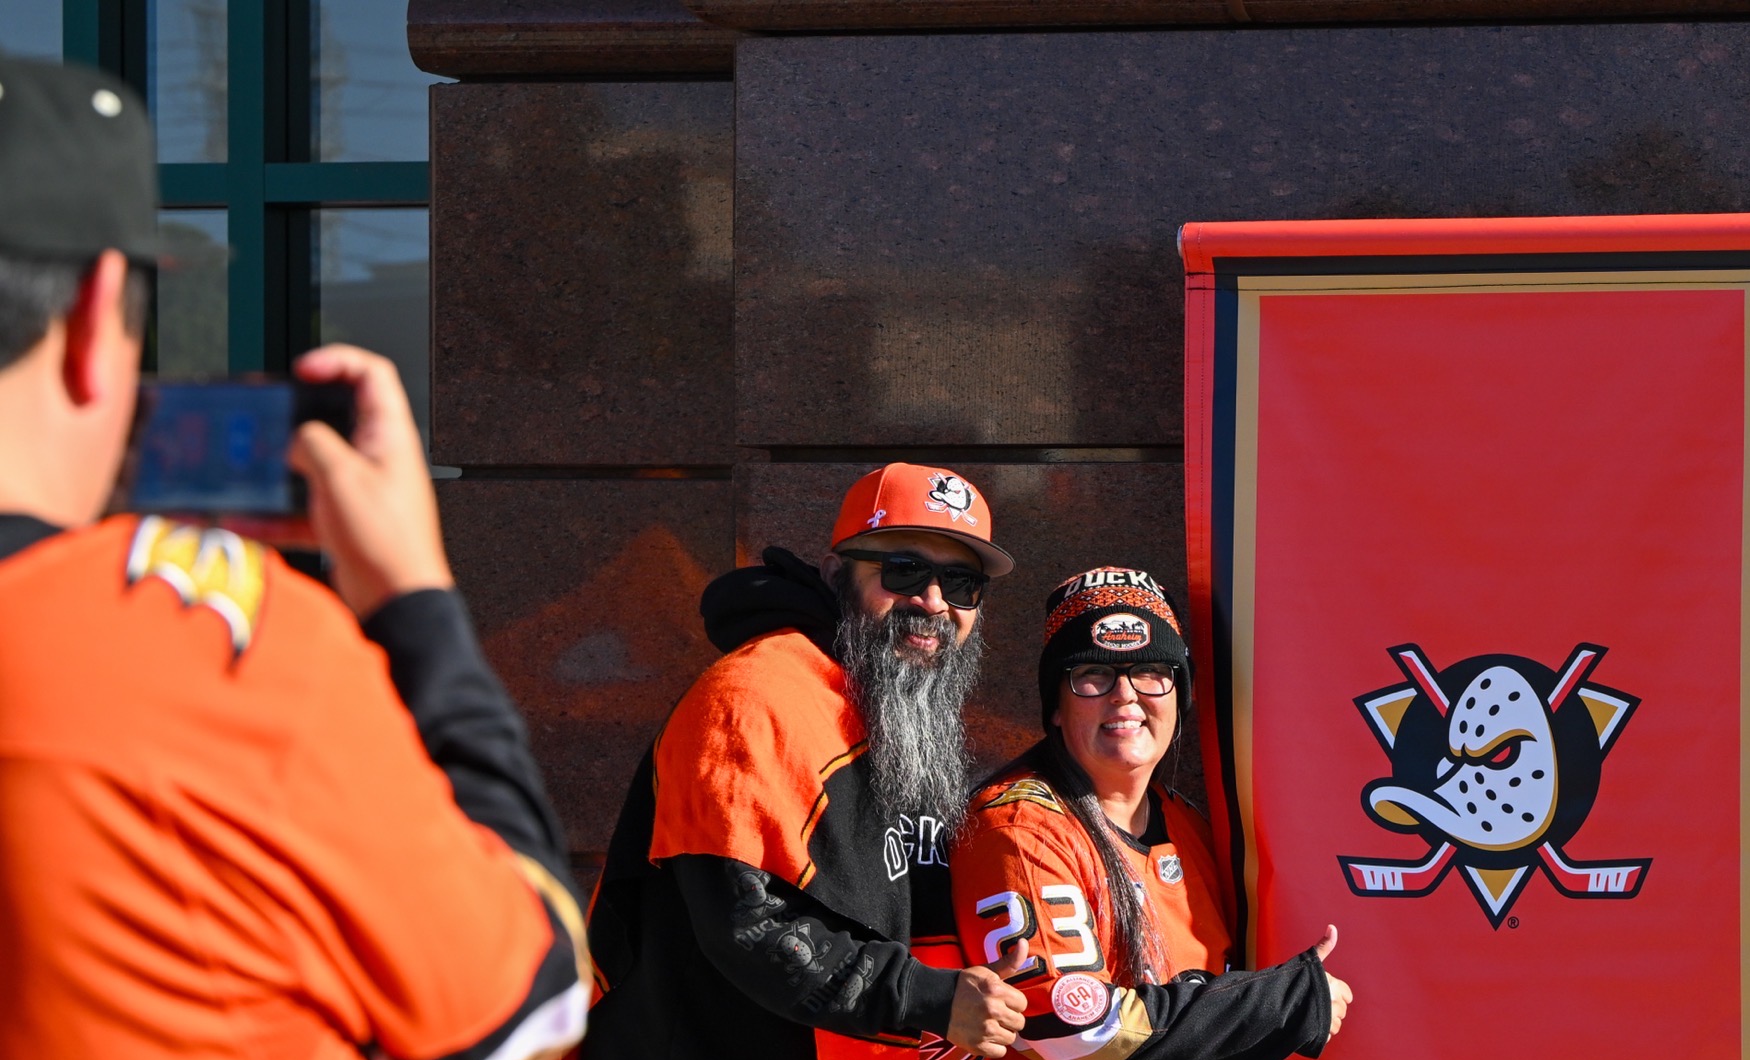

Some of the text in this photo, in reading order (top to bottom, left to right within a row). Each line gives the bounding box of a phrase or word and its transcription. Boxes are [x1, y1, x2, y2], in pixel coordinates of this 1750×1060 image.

[1064, 571, 1166, 600] DUCKS
[1103, 630, 1142, 641] Anaheim
[734, 917, 788, 951] DUCK
[976, 884, 1104, 984] 23
